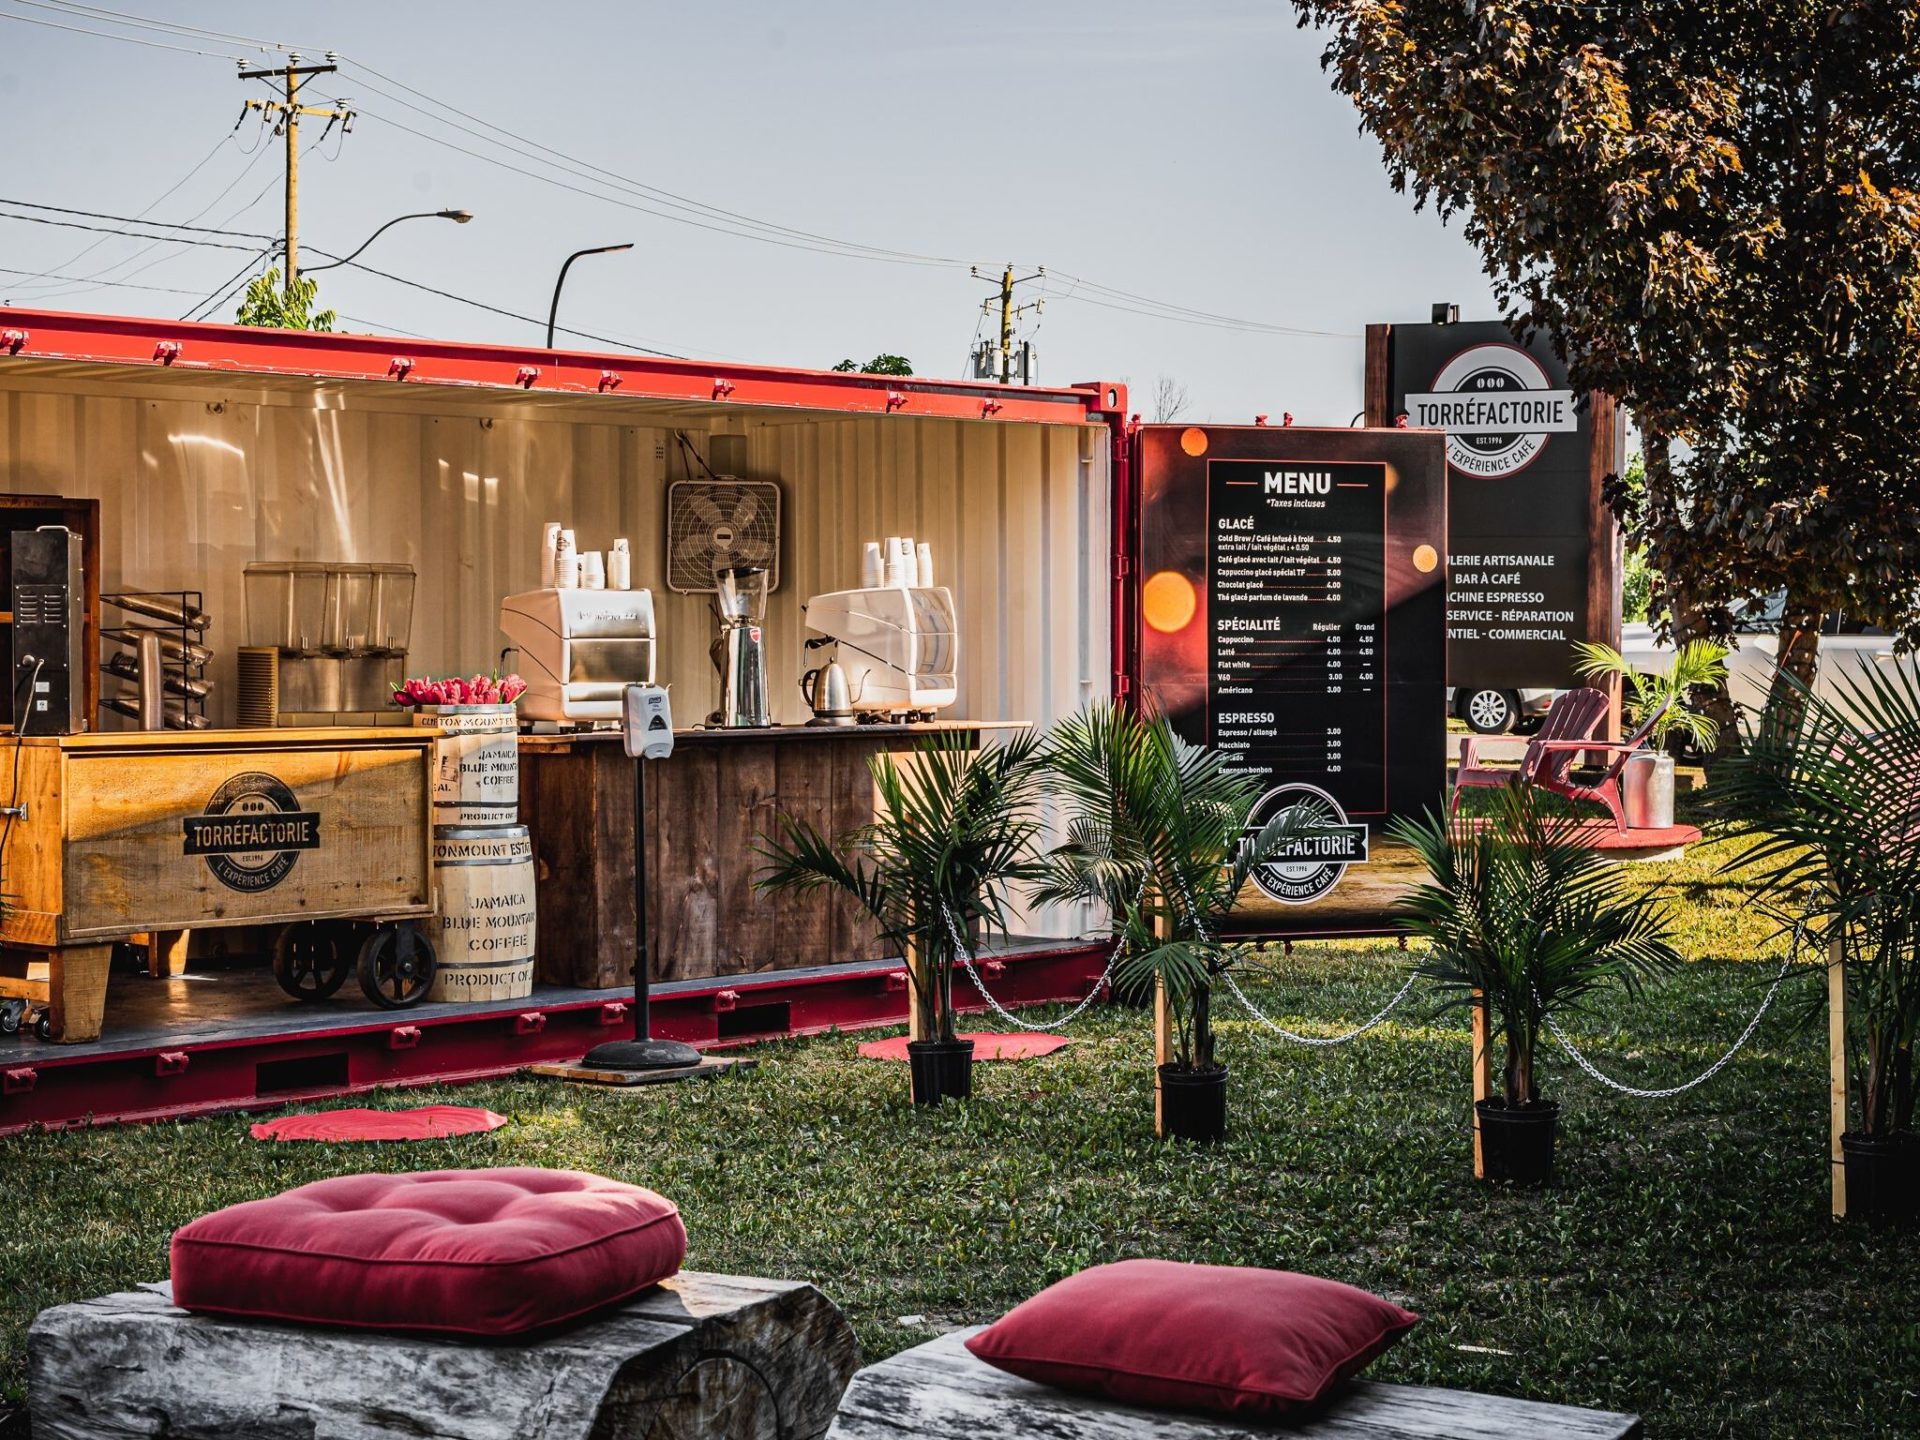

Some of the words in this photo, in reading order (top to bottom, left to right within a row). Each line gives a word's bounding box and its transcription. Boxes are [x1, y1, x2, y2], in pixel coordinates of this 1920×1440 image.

[1418, 398, 1563, 425] TORRÉFACTORIE
[1513, 439, 1535, 463] CAFÉ
[1264, 472, 1331, 494] MENU
[1294, 499, 1325, 507] incluses
[1219, 516, 1254, 529] GLACÉ
[1263, 544, 1286, 552] végétal
[1234, 556, 1250, 564] glacé
[1296, 556, 1320, 564] végétal
[1483, 556, 1554, 566] ARTISANALE
[1218, 569, 1253, 577] Cappuccino
[1255, 568, 1272, 577] glacé
[1273, 569, 1296, 577] spécial
[1455, 574, 1478, 584] BAR
[1480, 572, 1488, 584] À
[1491, 572, 1521, 584] CAFÉ
[1246, 581, 1263, 589] glacé
[1231, 593, 1248, 601] glacé
[1249, 594, 1272, 602] parfum
[1487, 592, 1544, 603] ESPRESSO
[1447, 611, 1492, 621] SERVICE
[1502, 609, 1574, 622] RÉPARATION
[1217, 617, 1280, 631] SPÉCIALITÉ
[1313, 623, 1341, 631] Régulier
[1447, 629, 1479, 639] NTIEL
[1489, 629, 1566, 640] COMMERCIAL
[1218, 713, 1274, 723] ESPRESSO
[1218, 729, 1247, 737] Espresso
[1253, 728, 1277, 737] allongé
[479, 750, 516, 760] JAMAICA
[460, 763, 487, 773] BLUE
[483, 776, 514, 785] COFFEE
[194, 820, 309, 847] TORRÉFACTORIE
[217, 861, 270, 886] L'EXPÉRIENCE
[1261, 871, 1315, 896] L'EXPÉRIENCE
[1315, 867, 1334, 889] CAFÉ
[471, 894, 525, 909] JAMAICA
[443, 917, 480, 929] BLUE
[469, 934, 528, 951] COFFEE
[445, 972, 515, 986] PRODUCT
